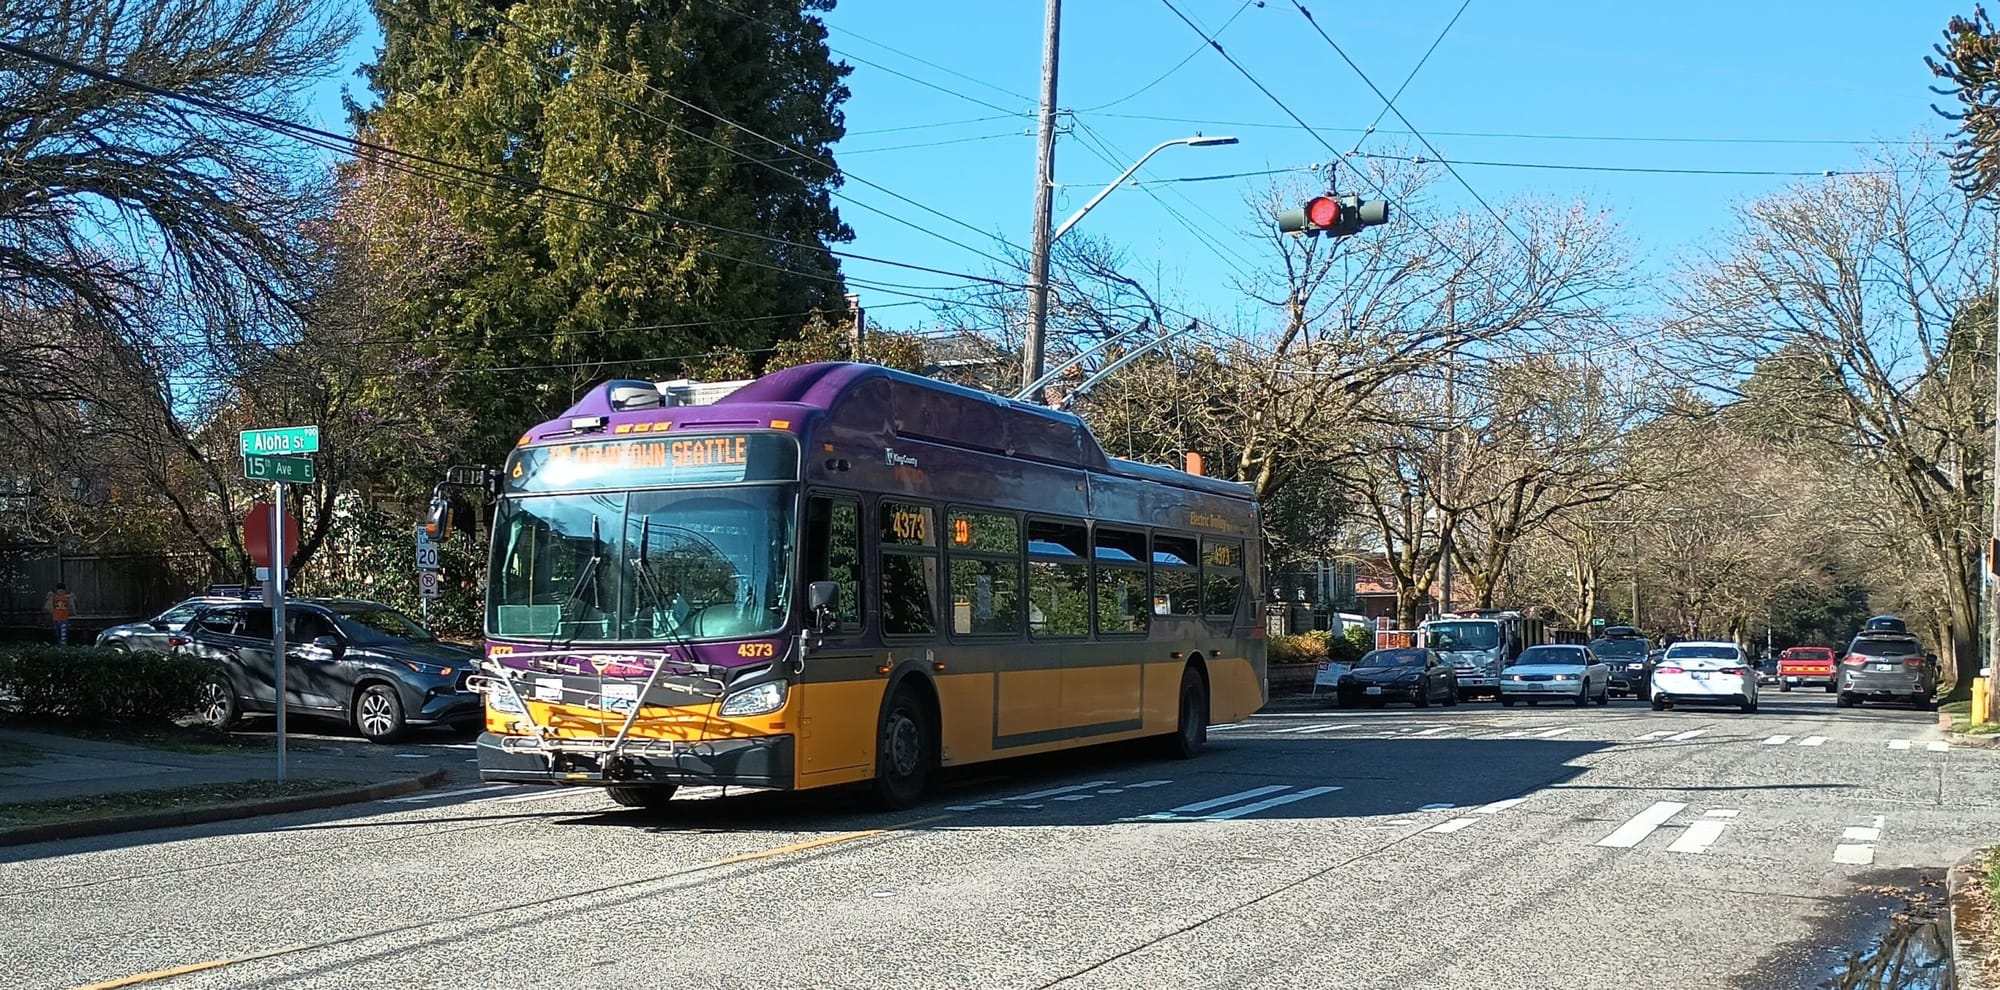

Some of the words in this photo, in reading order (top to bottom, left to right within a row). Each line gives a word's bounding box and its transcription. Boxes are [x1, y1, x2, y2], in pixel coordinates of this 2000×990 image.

[304, 428, 317, 437] 900
[243, 439, 249, 452] E
[254, 432, 290, 451] Aloha
[293, 434, 304, 449] St
[671, 437, 746, 466] SEATTLE
[276, 462, 292, 475] Ave
[304, 465, 311, 477] E
[893, 511, 926, 540] 4373
[419, 549, 436, 564] 20
[737, 643, 774, 657] 4373
